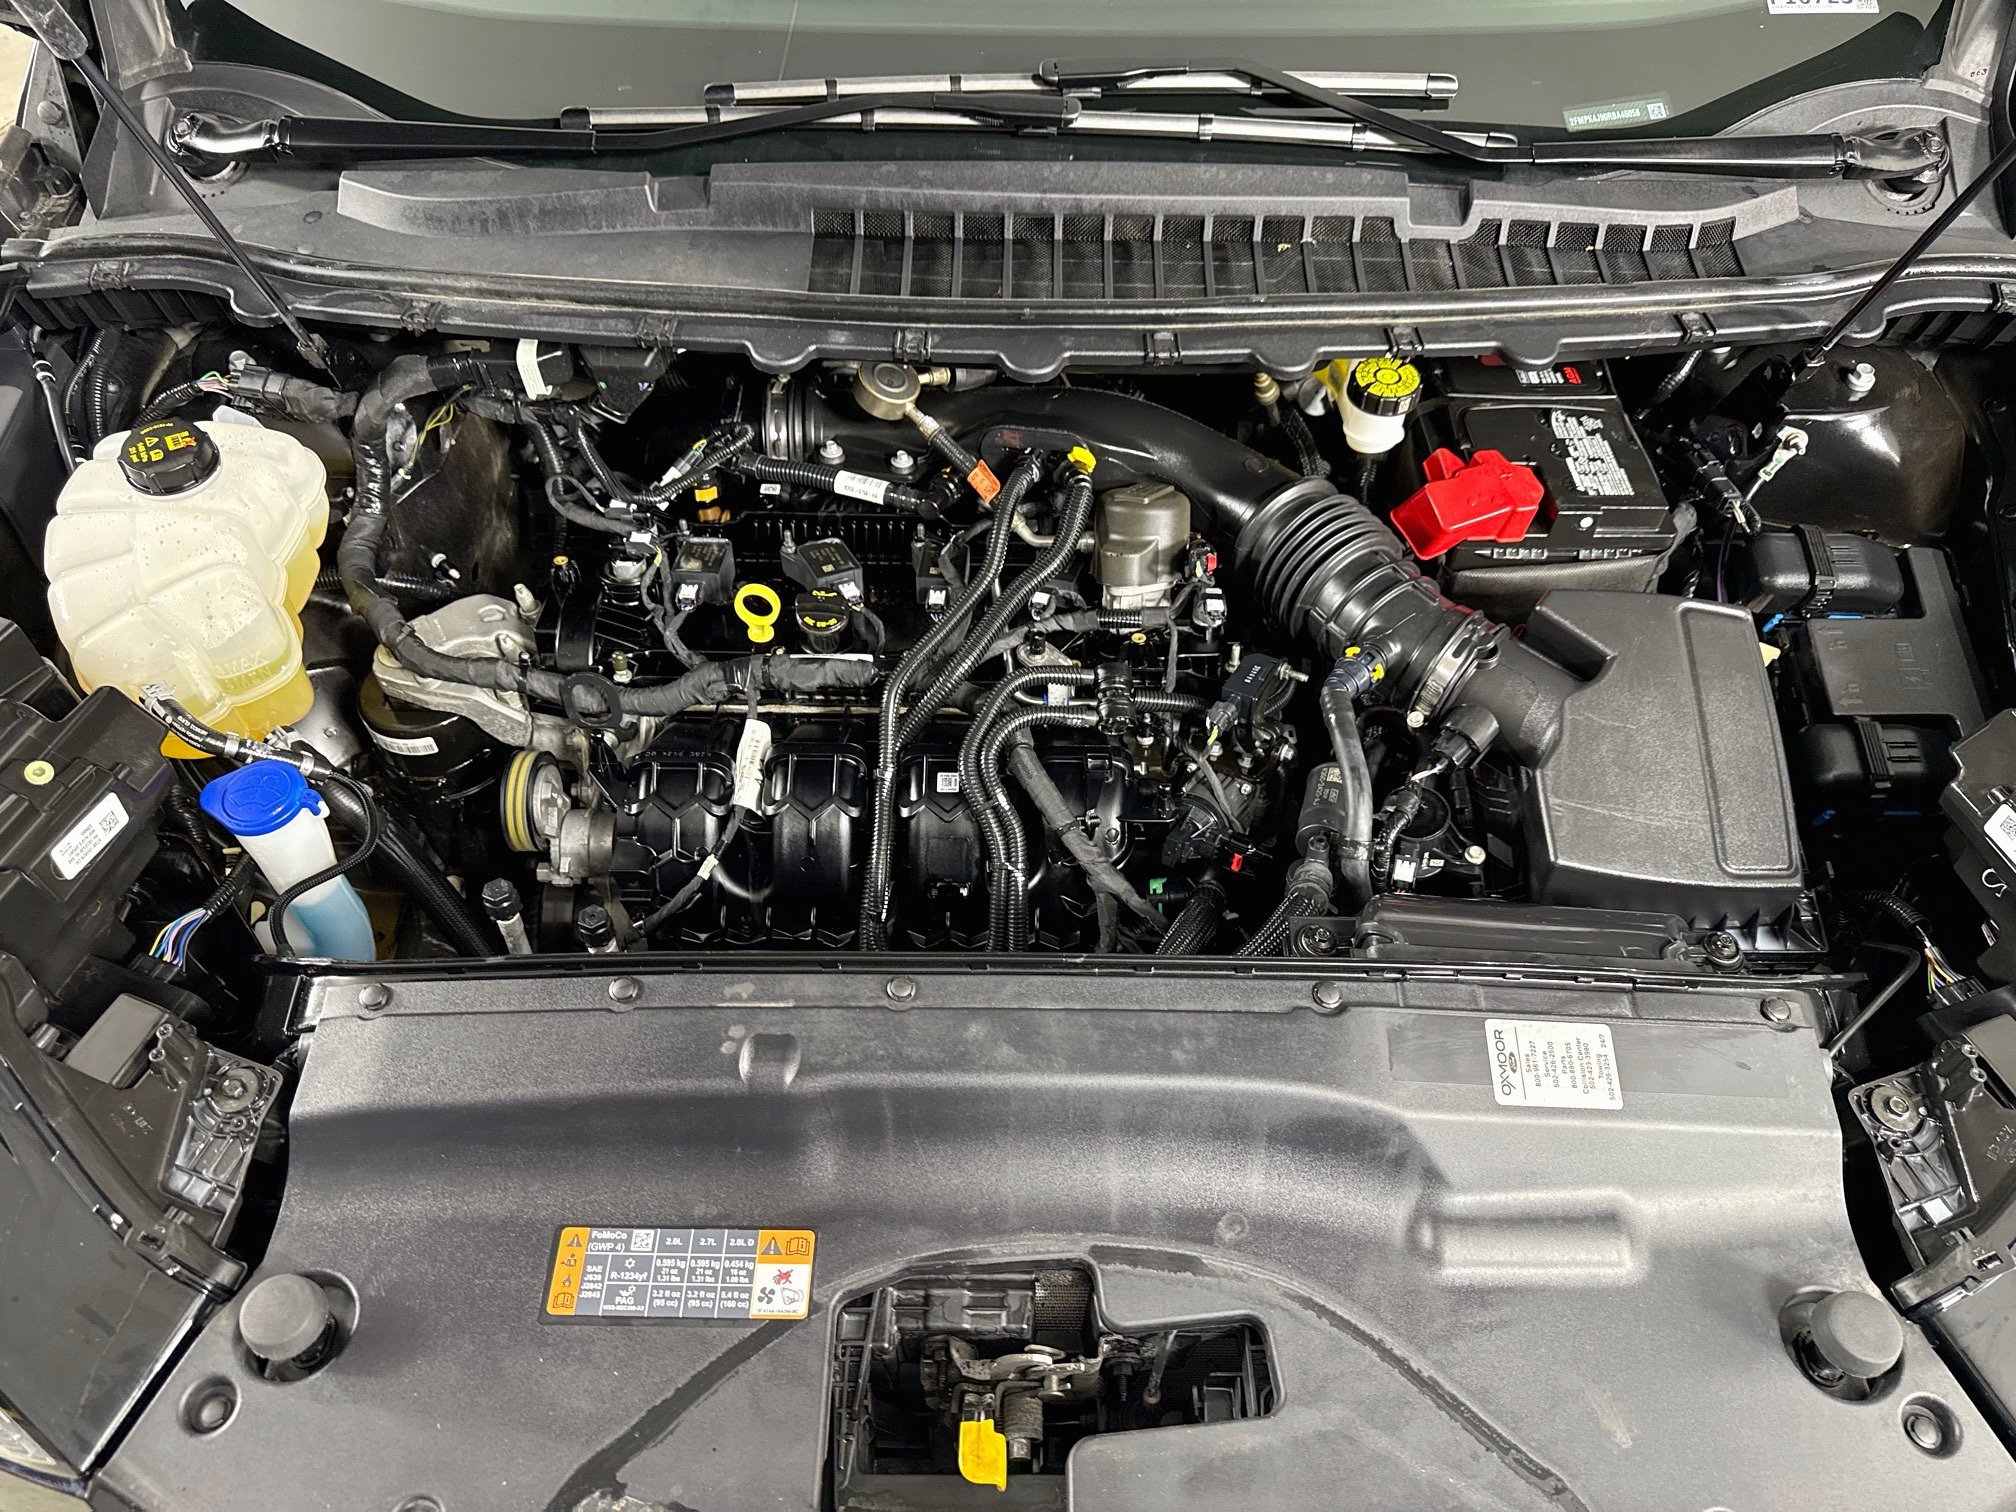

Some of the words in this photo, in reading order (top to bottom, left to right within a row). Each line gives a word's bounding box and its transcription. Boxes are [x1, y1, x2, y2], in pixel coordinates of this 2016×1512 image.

[803, 616, 815, 626] SAE
[1598, 1034, 1608, 1048] 24/7
[1576, 1037, 1584, 1061] Center
[1494, 1029, 1516, 1096] OXMOOR
[1542, 1050, 1551, 1078] Service
[1580, 1062, 1589, 1094] Collision
[592, 1230, 628, 1240] FoMoCo
[666, 1237, 683, 1246] 2.0L
[700, 1238, 717, 1246] 2.7L
[730, 1238, 746, 1246] 2.0L
[588, 1242, 614, 1252] (GWP
[616, 1242, 626, 1253] 4)
[656, 1258, 676, 1267] 0.595
[676, 1259, 686, 1269] kg
[690, 1259, 710, 1267] 0.595
[711, 1260, 721, 1270] kg
[724, 1260, 744, 1268] 0.454
[745, 1260, 755, 1270] kg
[610, 1272, 648, 1282] R-1234yf
[653, 1300, 666, 1308] (95
[667, 1300, 678, 1308] cc)
[688, 1300, 701, 1309] (95
[702, 1300, 713, 1309] cc)
[720, 1301, 736, 1309] (160
